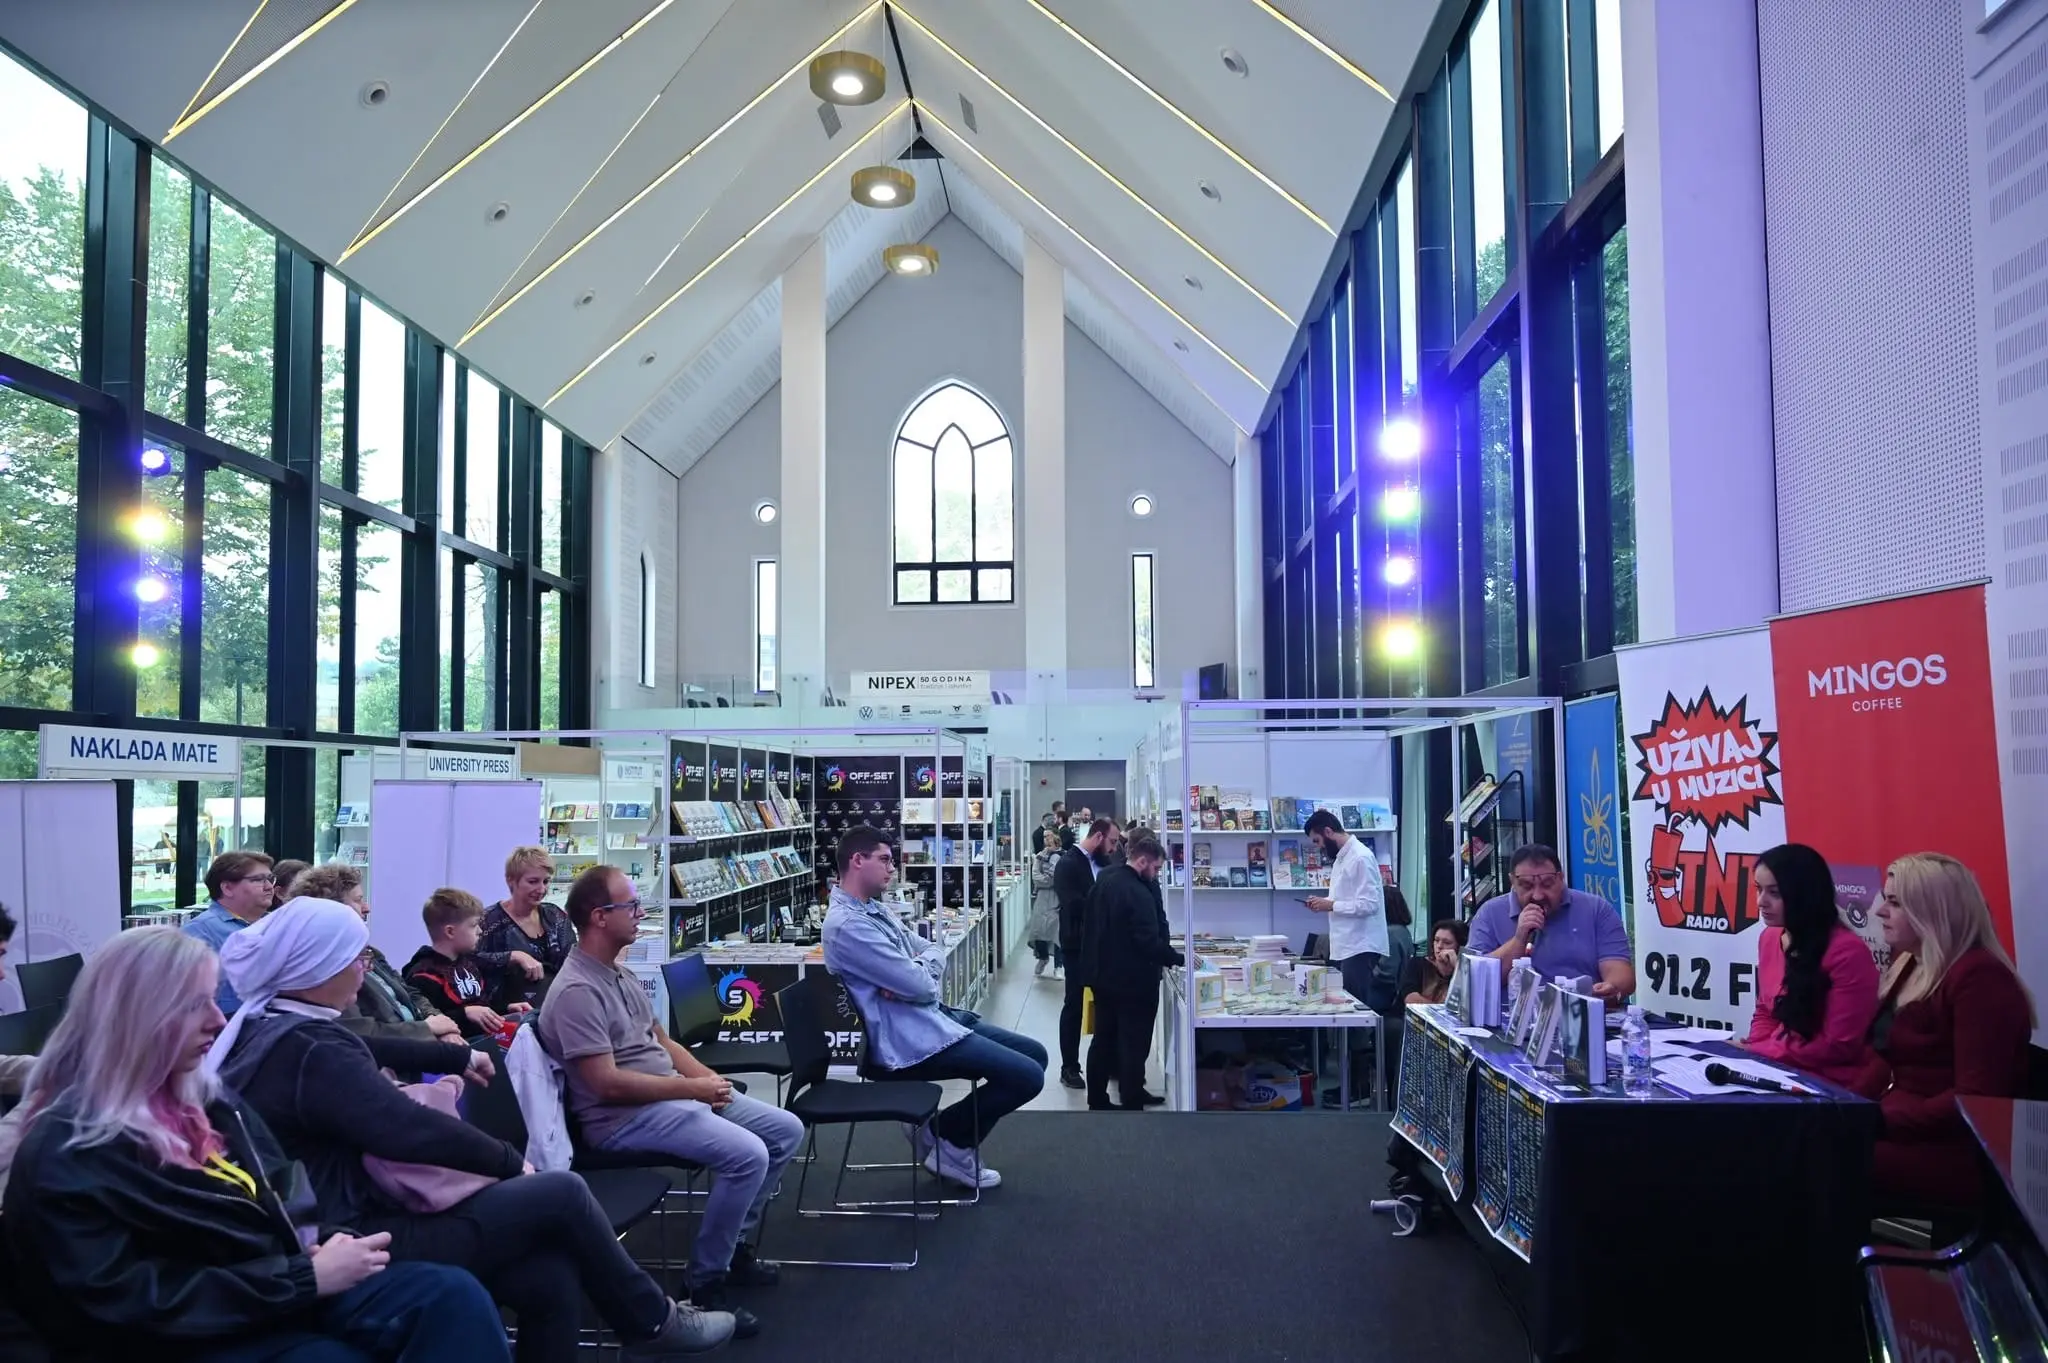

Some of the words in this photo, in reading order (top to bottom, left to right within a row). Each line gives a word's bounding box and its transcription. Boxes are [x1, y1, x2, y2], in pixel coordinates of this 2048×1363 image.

[868, 676, 916, 689] NIPEX
[931, 675, 972, 683] GODINA
[1808, 654, 1947, 697] MINGOS
[1852, 697, 1903, 712] COFFEE
[70, 735, 167, 761] NAKLADA
[172, 742, 218, 763] MATE
[1646, 725, 1764, 775] UŽIVAJ
[429, 756, 482, 772] UNIVERSITY
[483, 759, 510, 773] PRESS
[685, 765, 705, 777] OFF-SET
[850, 771, 894, 780] OFF-SET
[1651, 779, 1671, 805] U
[1678, 764, 1765, 801] MUZICI
[1583, 873, 1619, 902] BKC
[1677, 833, 1760, 933] TNT
[1834, 884, 1867, 895] MINGOS
[1686, 914, 1729, 931] RADIO
[1645, 951, 1711, 1001] 91.2
[1729, 962, 1758, 1006] F
[824, 1031, 862, 1048] OFF
